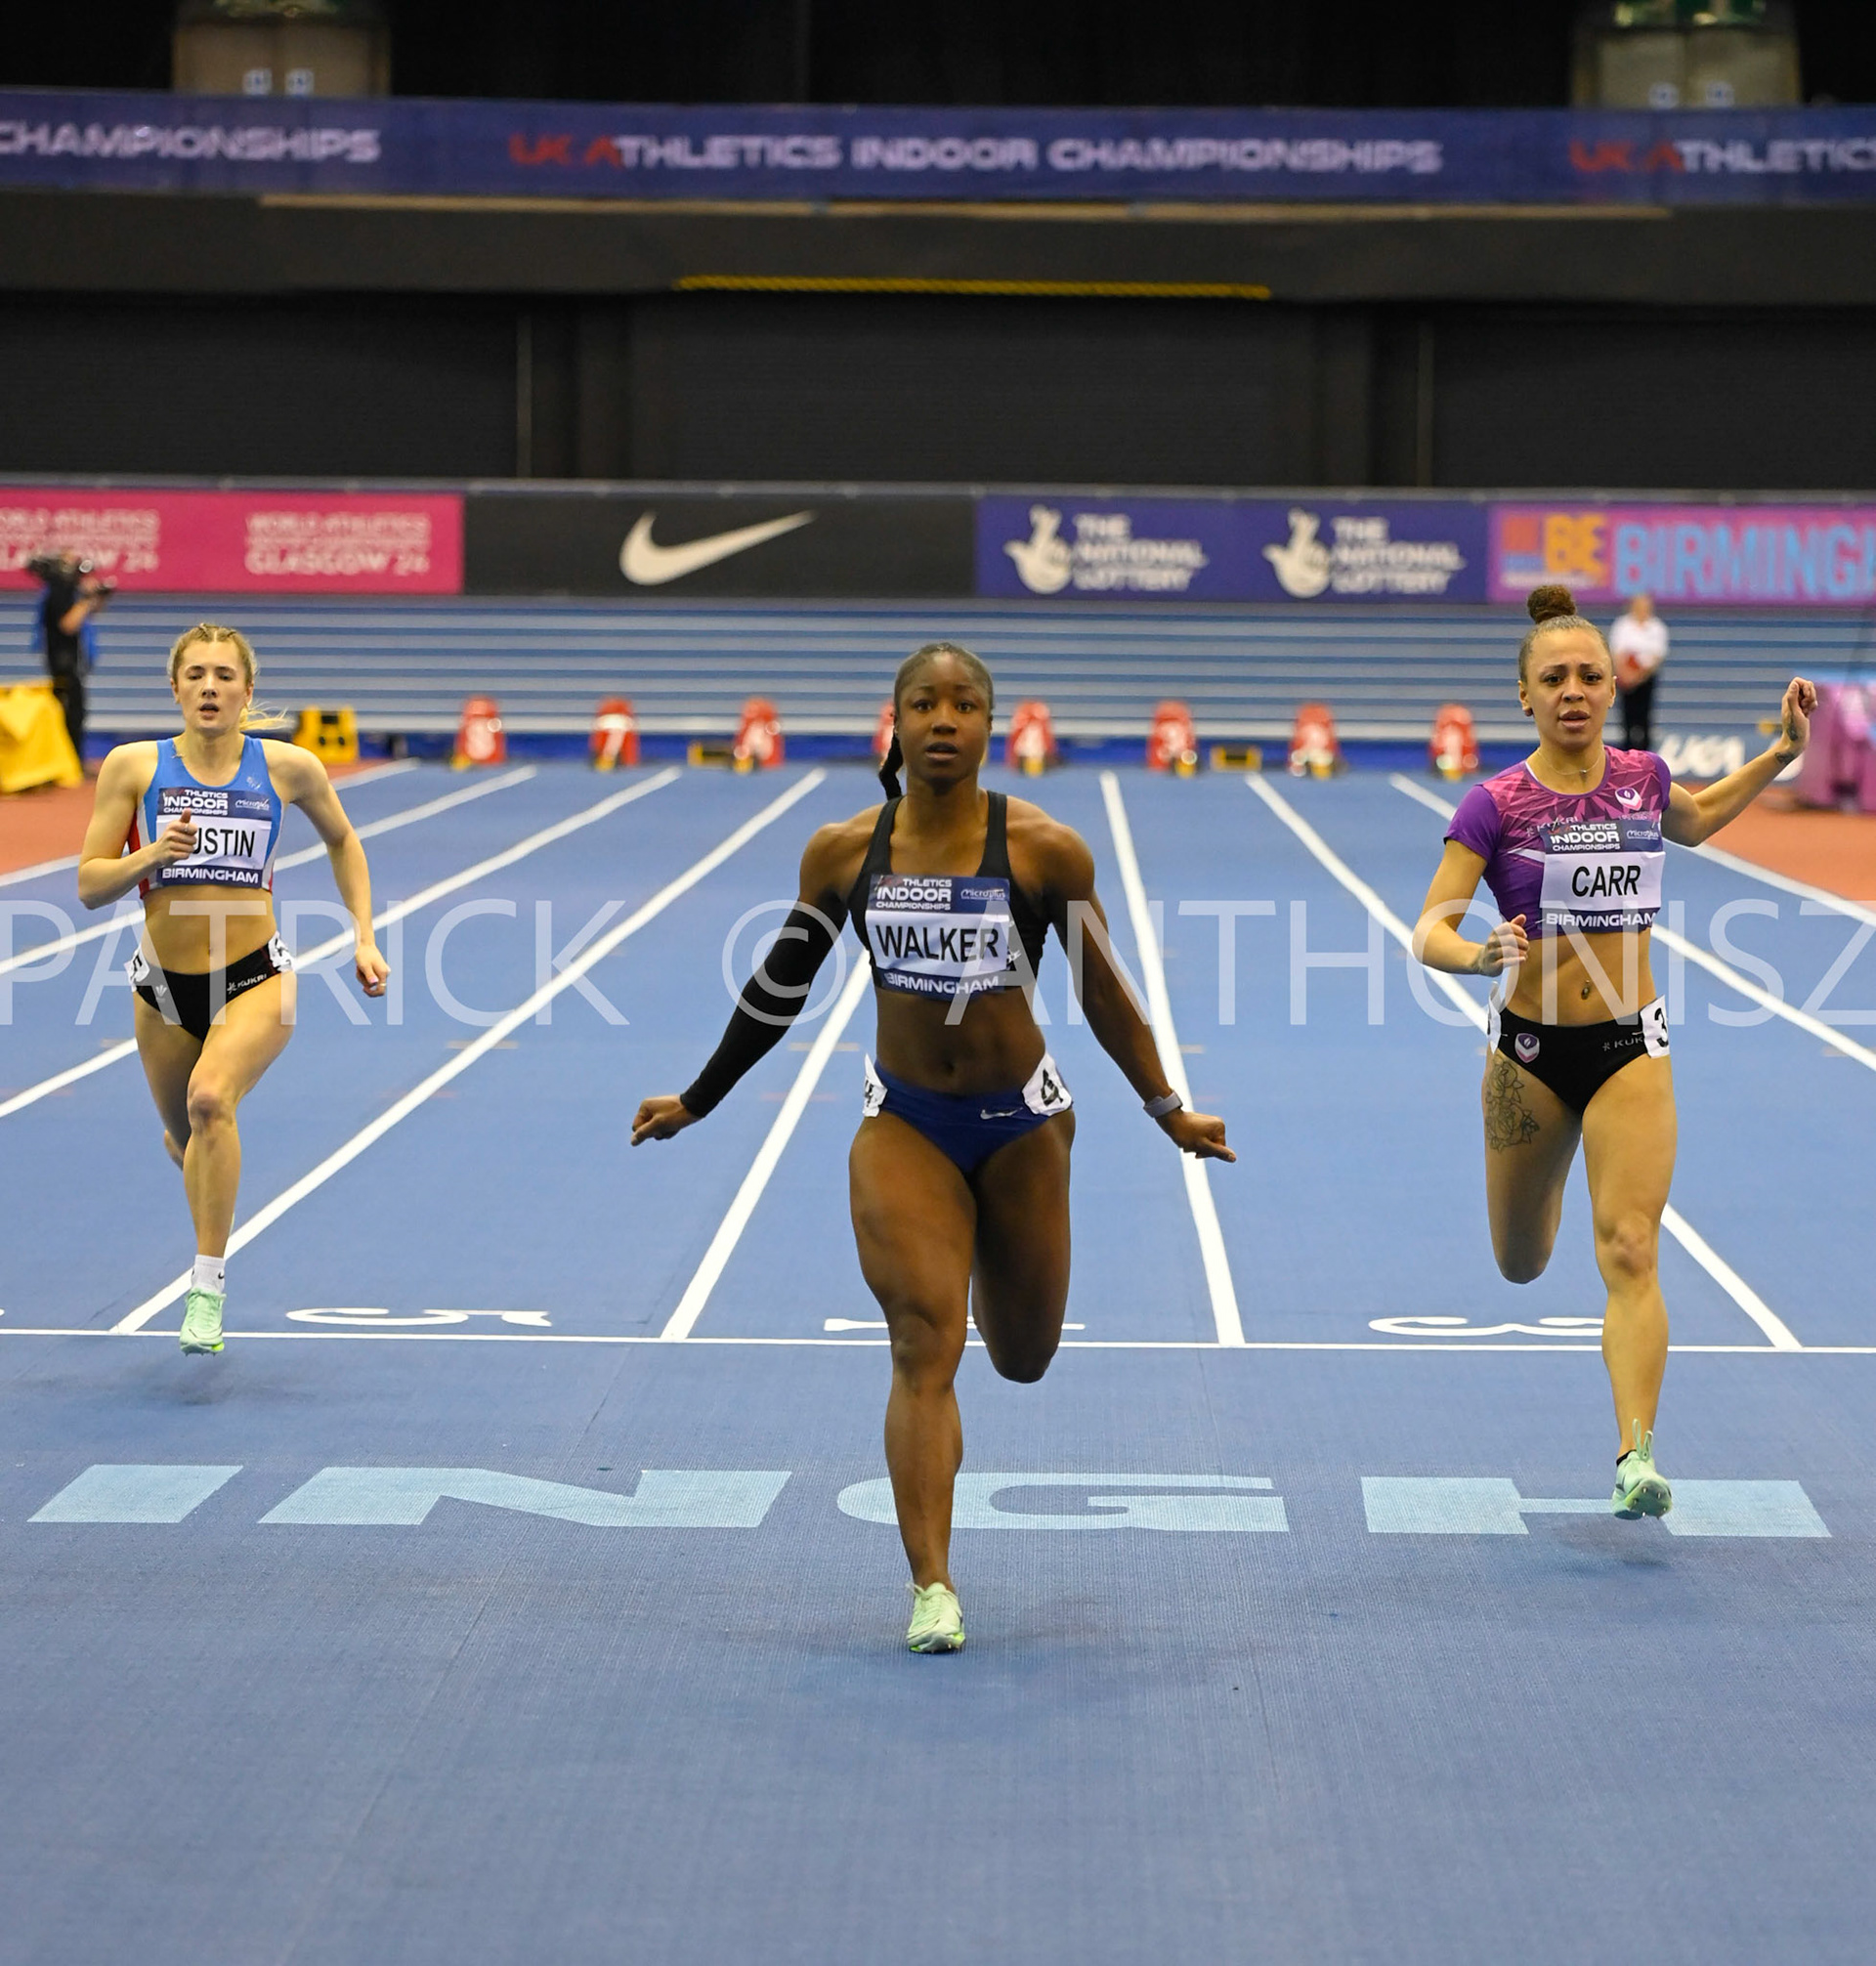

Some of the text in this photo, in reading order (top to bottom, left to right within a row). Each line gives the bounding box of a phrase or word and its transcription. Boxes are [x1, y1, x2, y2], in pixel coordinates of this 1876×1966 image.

[508, 133, 1444, 175] UK ATHLETICS INDOOR CHAMPIONSHIPS
[1568, 138, 1635, 174] UK
[1544, 512, 1607, 580] BE
[245, 549, 388, 576] GLASGOW
[163, 795, 229, 810] INDOOR
[1551, 832, 1620, 844] INDOOR
[1553, 843, 1620, 852] CHAMPIONSHIPS
[161, 868, 259, 884] BIRMINGHAM
[1571, 865, 1641, 897] CARR
[875, 901, 951, 911] CHAMPIONSHIPS
[877, 887, 952, 902] INDOOR
[875, 925, 999, 962] WALKER
[884, 973, 999, 995] BIRMINGHAM
[1654, 1007, 1669, 1047] 3
